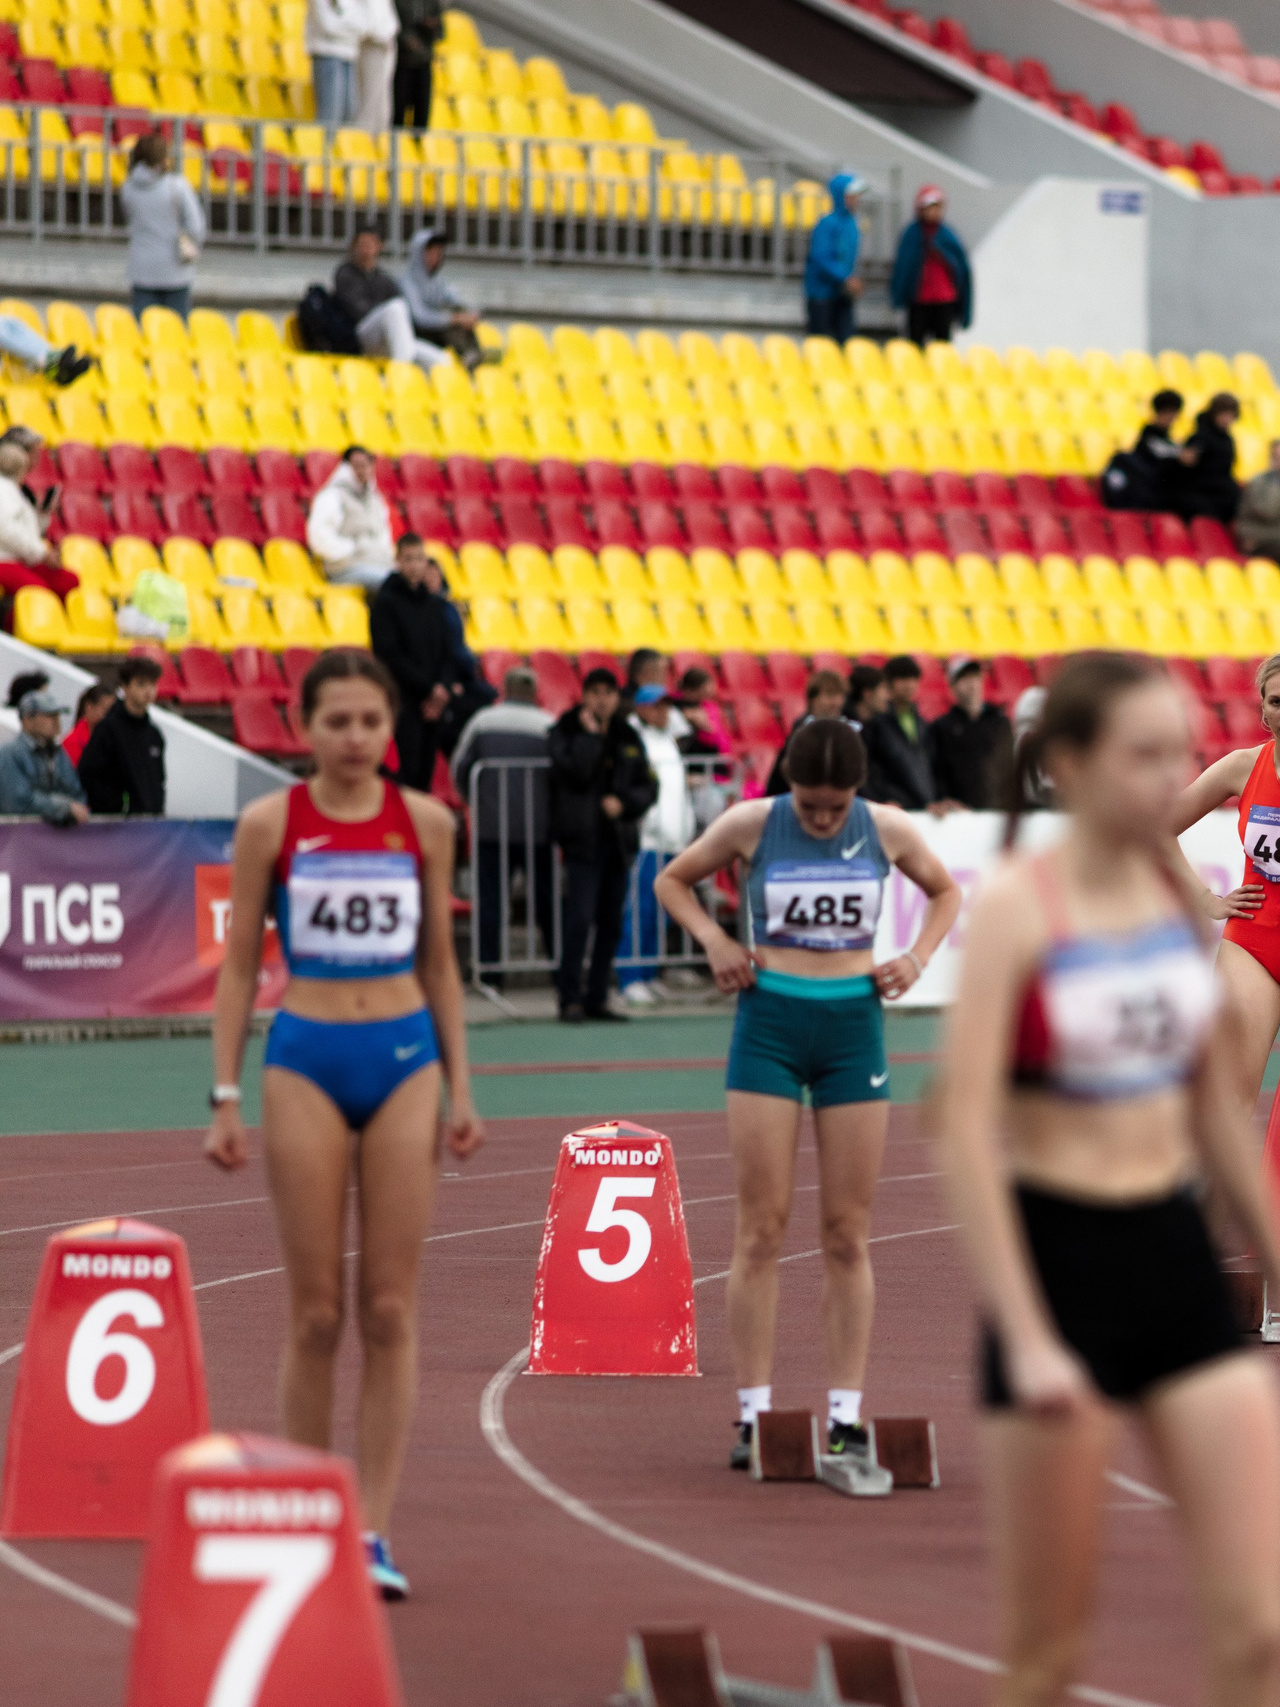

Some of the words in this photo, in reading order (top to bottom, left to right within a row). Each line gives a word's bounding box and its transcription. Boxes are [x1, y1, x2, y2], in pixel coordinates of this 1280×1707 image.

[22, 882, 125, 946] ПСБ
[308, 893, 400, 936] 483
[784, 894, 863, 927] 485
[574, 1148, 660, 1167] MONDO
[576, 1176, 657, 1284] 5
[61, 1253, 172, 1280] MONDO
[65, 1288, 165, 1425] 6
[184, 1487, 343, 1531] MONDO
[192, 1534, 336, 1707] 7
